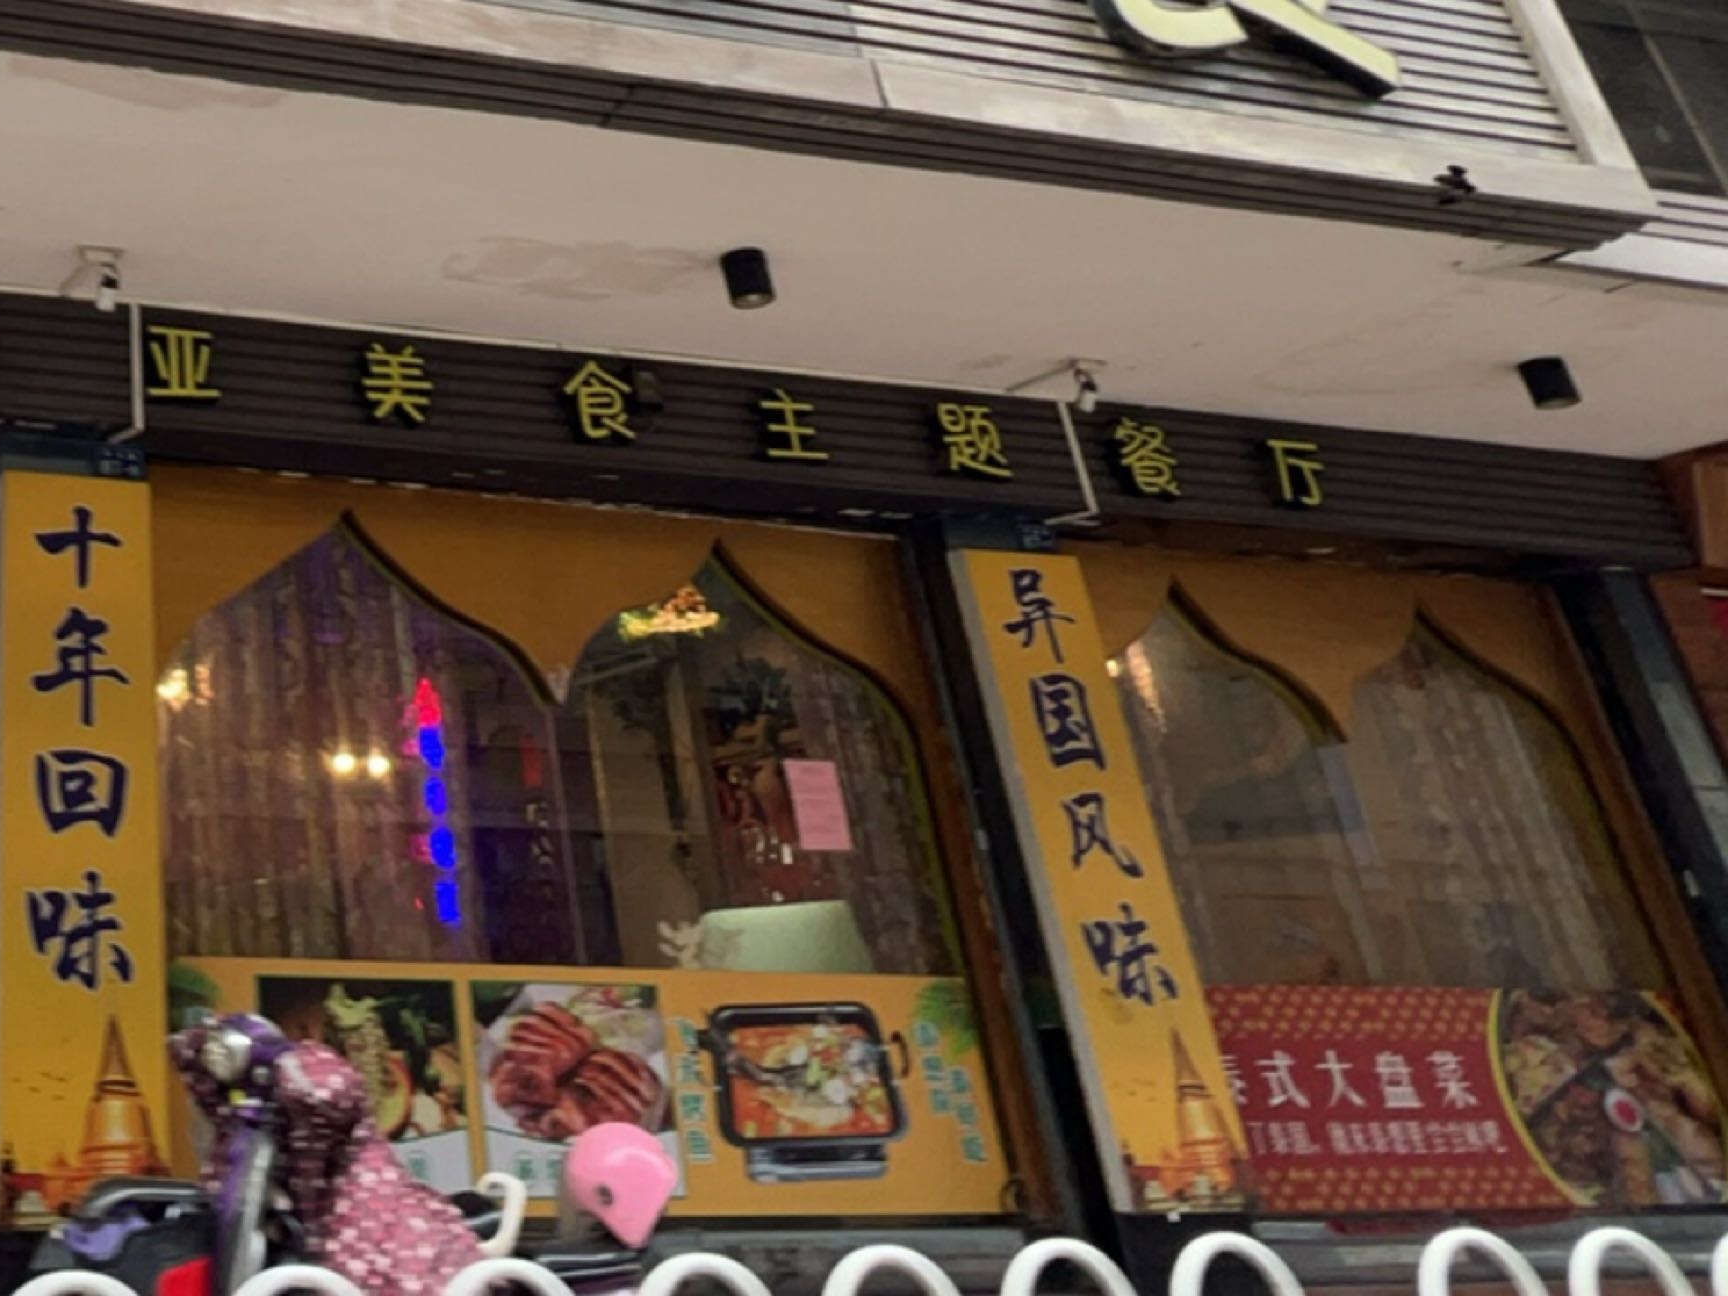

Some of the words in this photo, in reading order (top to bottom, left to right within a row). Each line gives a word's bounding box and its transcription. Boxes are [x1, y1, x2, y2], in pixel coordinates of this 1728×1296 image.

[25, 505, 135, 992] 十年回味
[1002, 567, 1178, 1005] 异国风味
